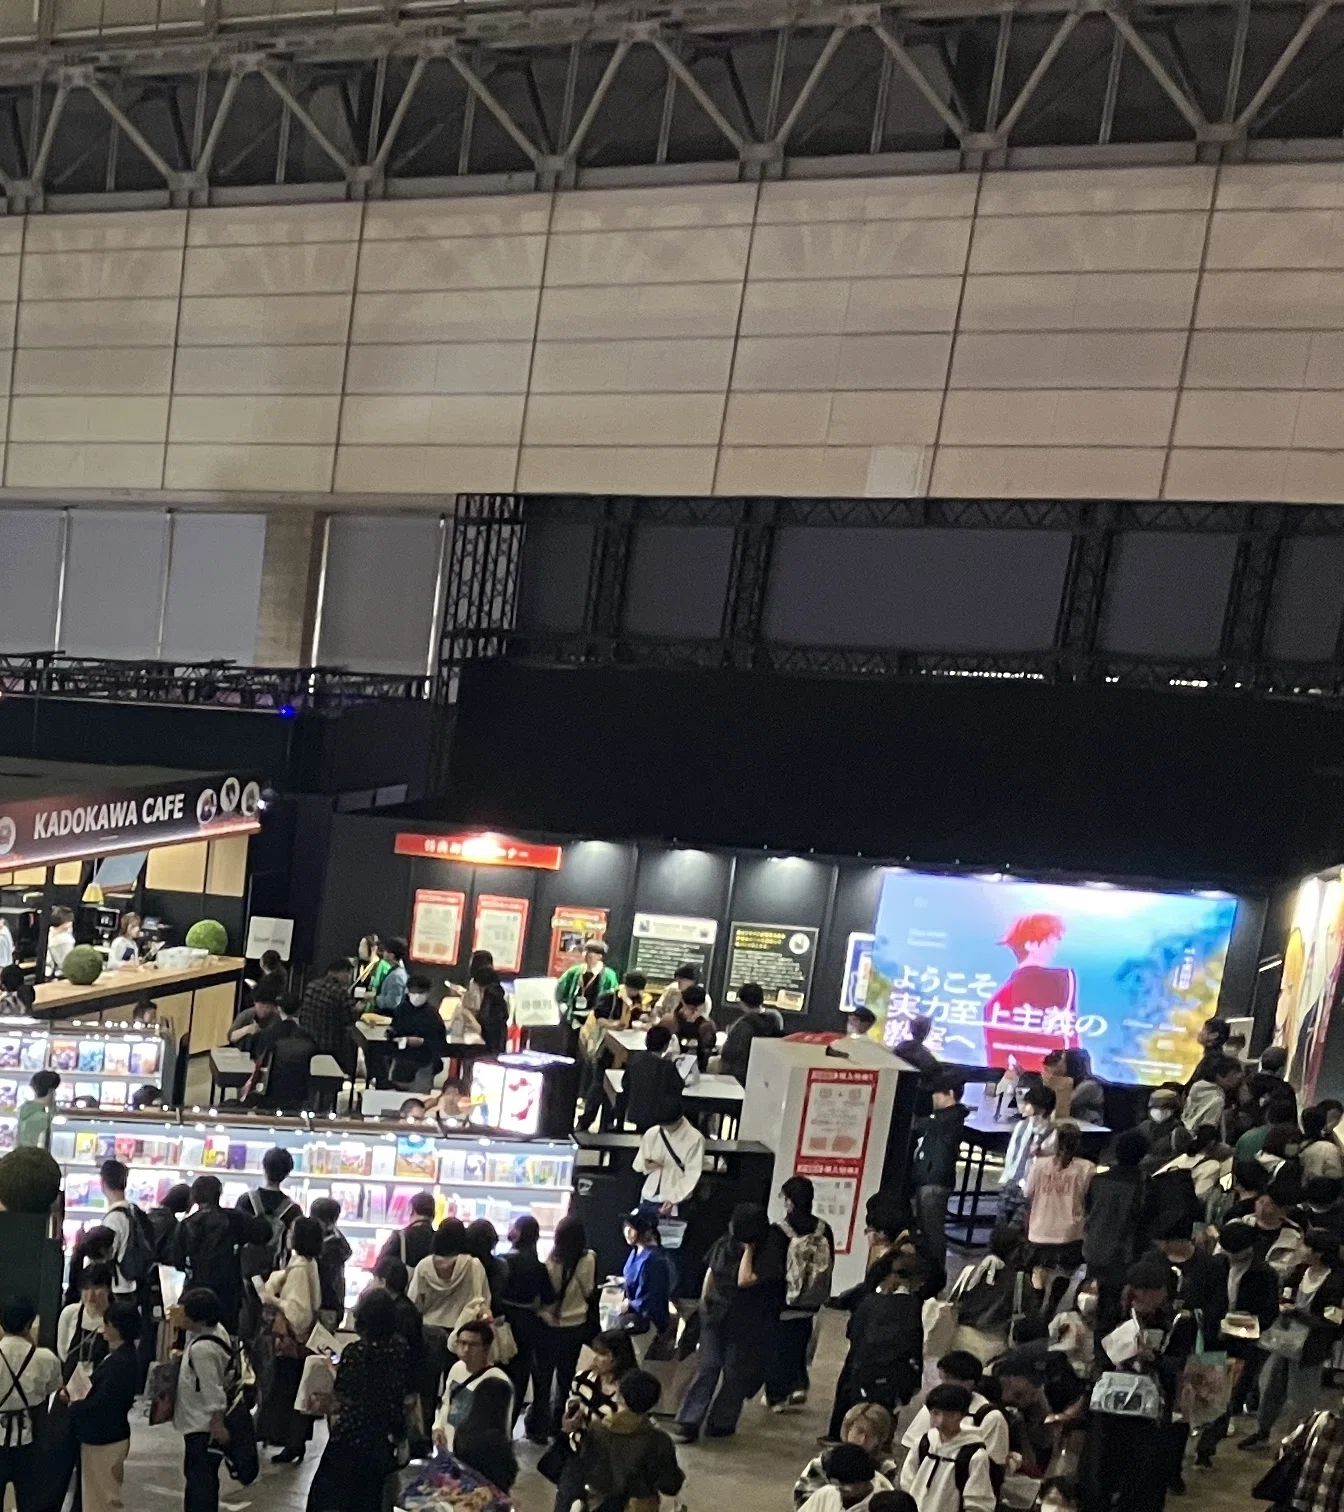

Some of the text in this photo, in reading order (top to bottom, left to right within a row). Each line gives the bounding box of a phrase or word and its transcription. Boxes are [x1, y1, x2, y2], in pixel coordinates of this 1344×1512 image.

[32, 792, 185, 840] KADOKAWA CAFE
[893, 965, 997, 999] ようこそ
[887, 991, 1108, 1038] 実力至上主義の
